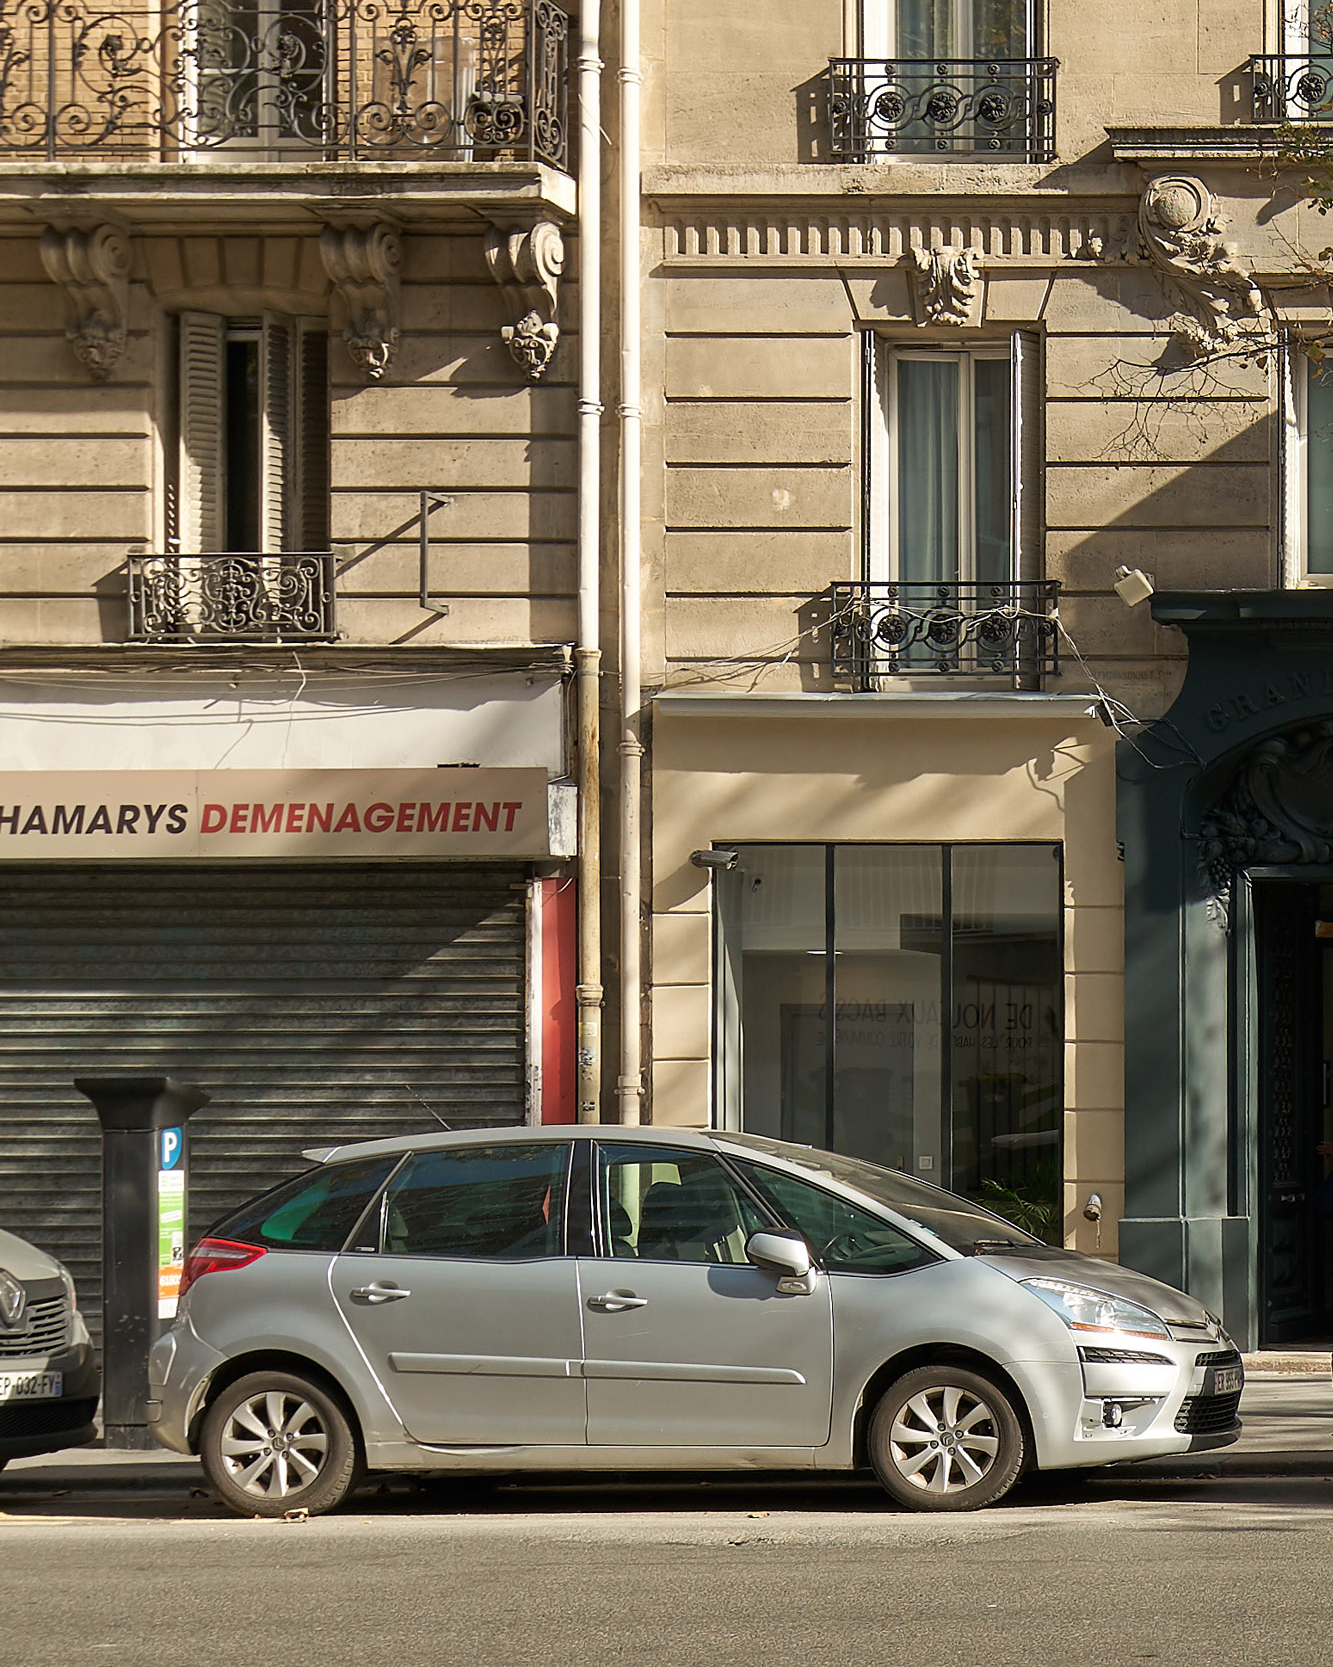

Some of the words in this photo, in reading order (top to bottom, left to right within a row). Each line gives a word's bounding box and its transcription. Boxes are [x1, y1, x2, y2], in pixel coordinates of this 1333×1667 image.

[0, 804, 189, 836] HAMARYS
[199, 801, 524, 835] DEMENAGEMENT
[164, 1131, 178, 1163] P
